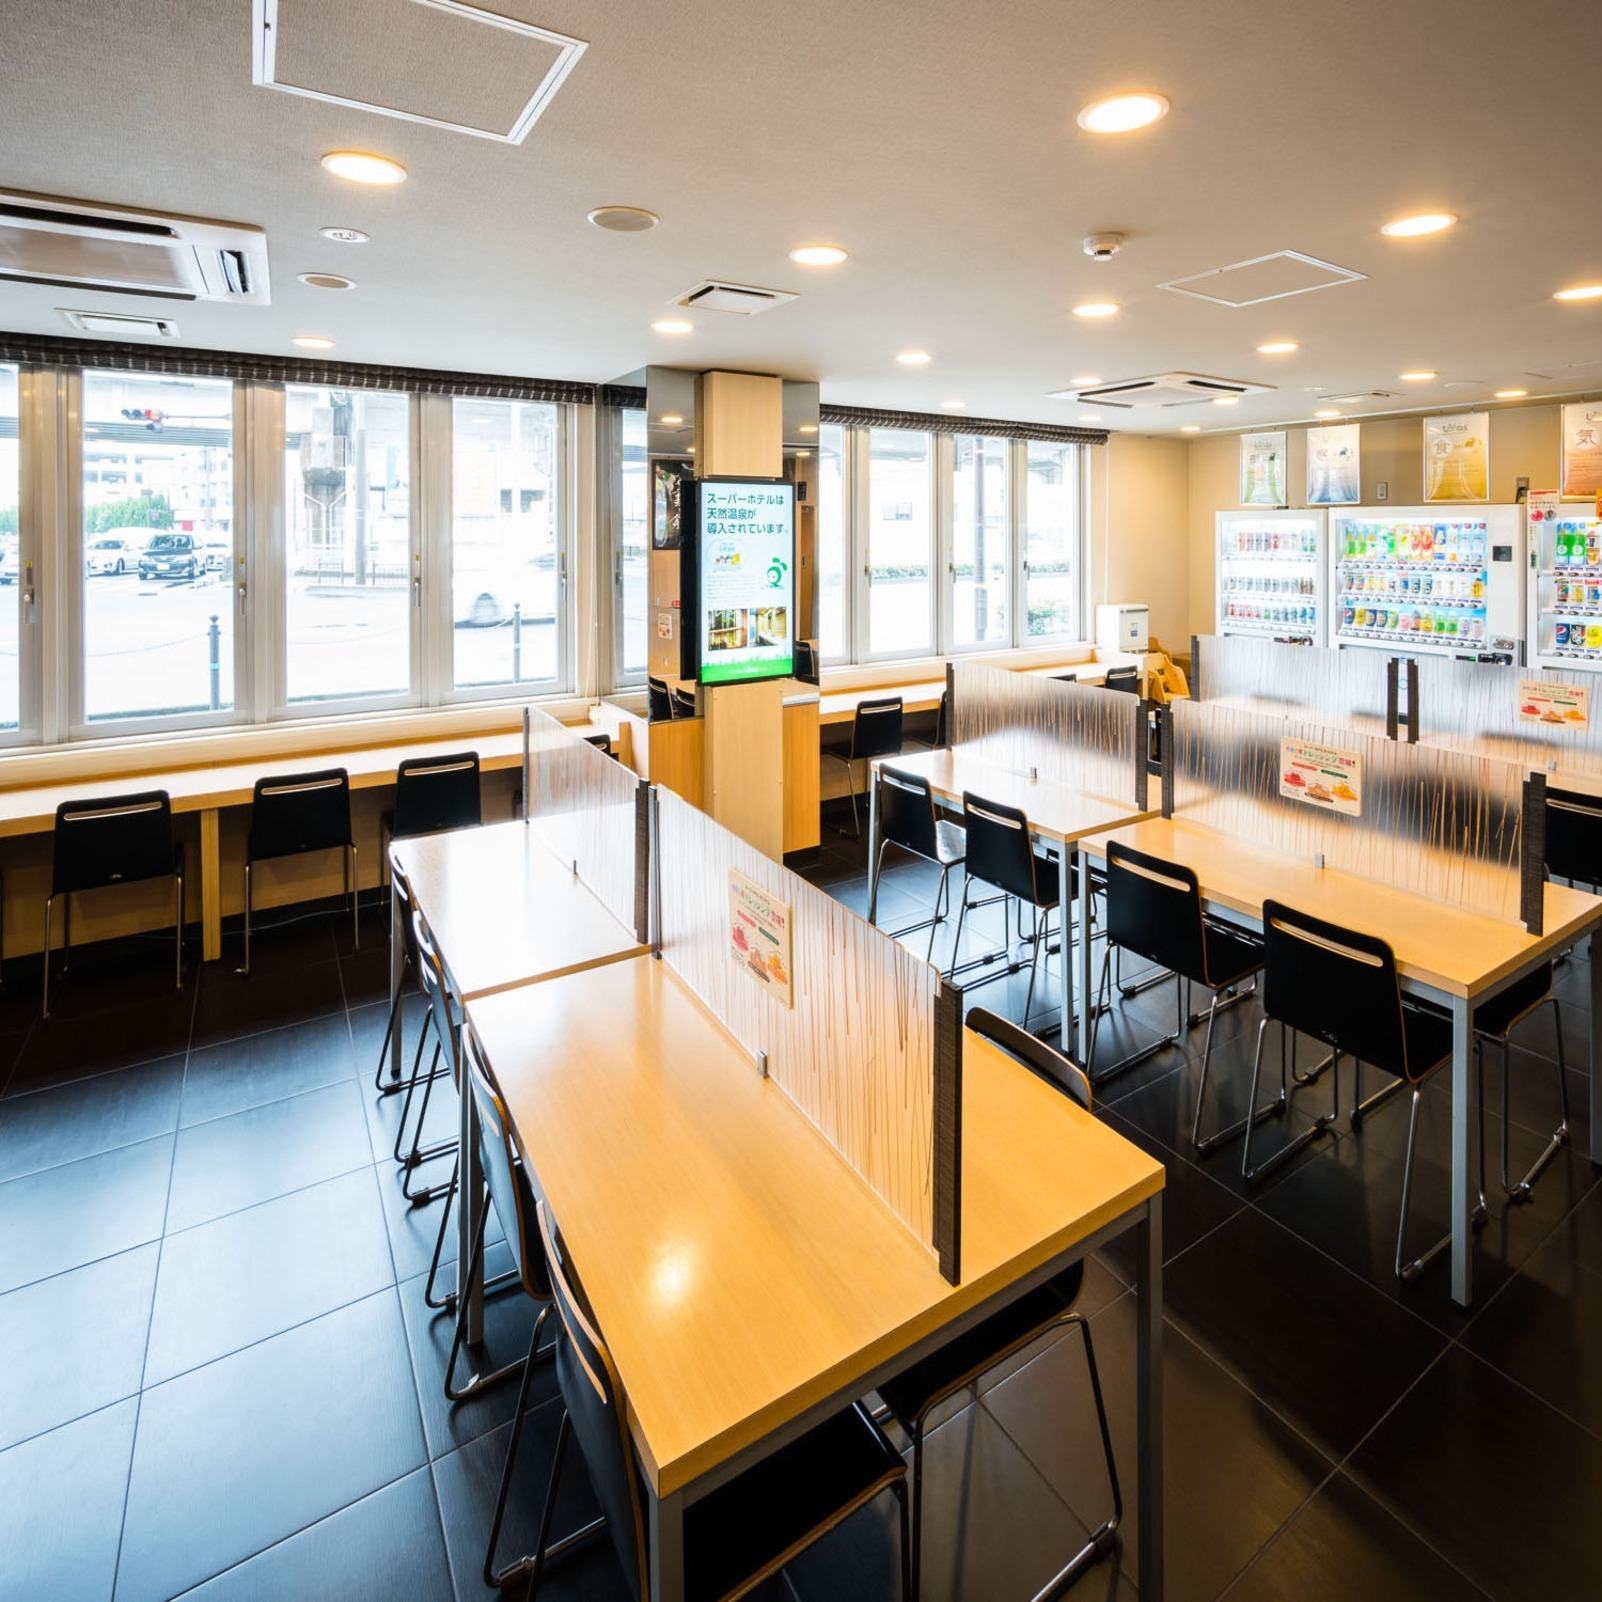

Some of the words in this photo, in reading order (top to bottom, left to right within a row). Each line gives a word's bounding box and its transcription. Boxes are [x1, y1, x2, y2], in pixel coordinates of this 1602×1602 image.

[1576, 429, 1597, 447] 気
[1433, 439, 1450, 455] 食
[707, 493, 785, 505] スーパーホテルは
[707, 508, 757, 520] 天然温泉が
